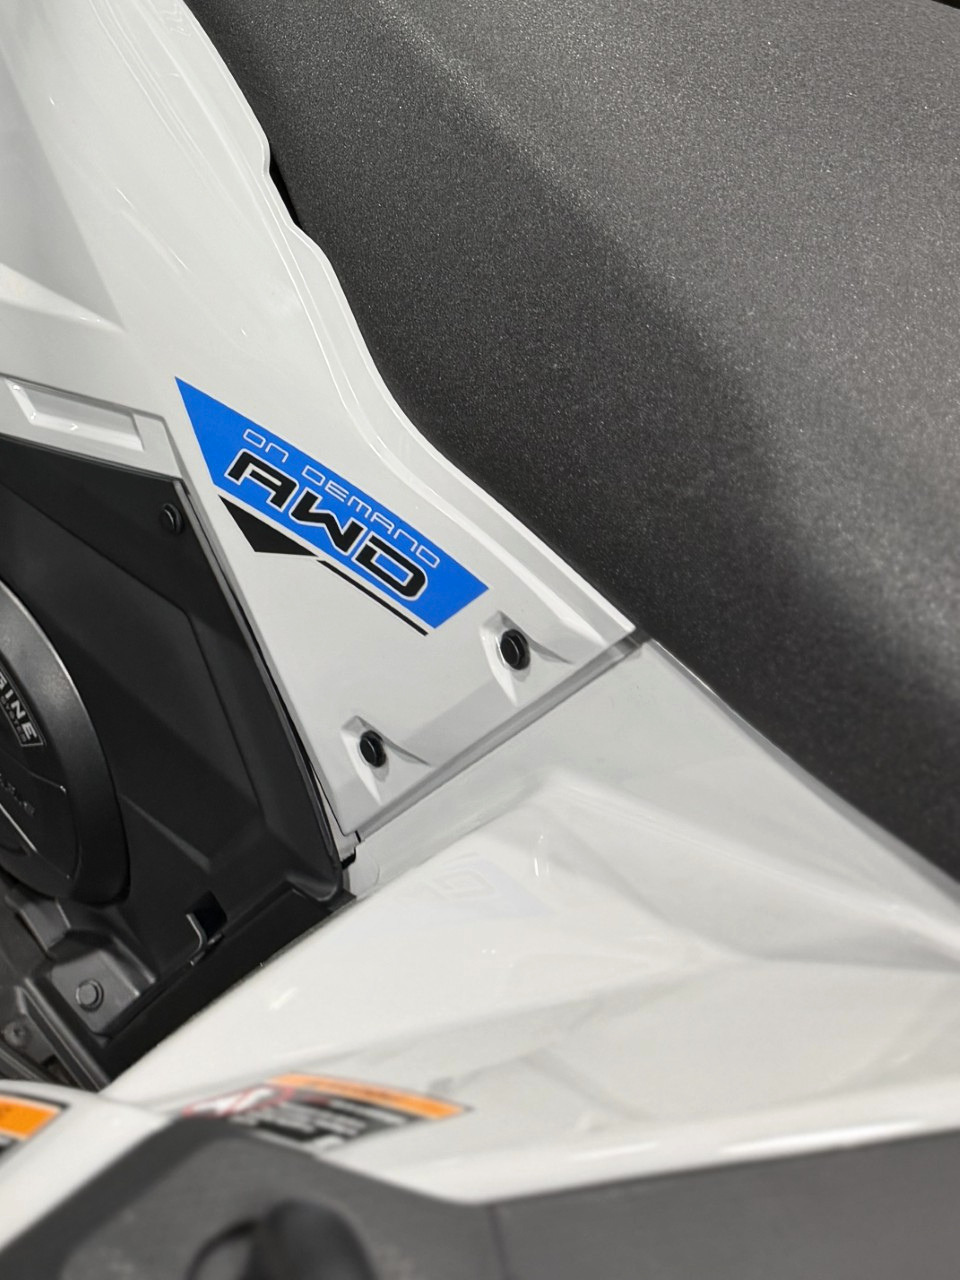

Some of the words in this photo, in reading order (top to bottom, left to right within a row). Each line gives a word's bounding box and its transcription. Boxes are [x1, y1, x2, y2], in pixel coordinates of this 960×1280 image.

[224, 448, 429, 602] AWD
[243, 428, 289, 463] ON
[301, 465, 440, 569] DEMAND
